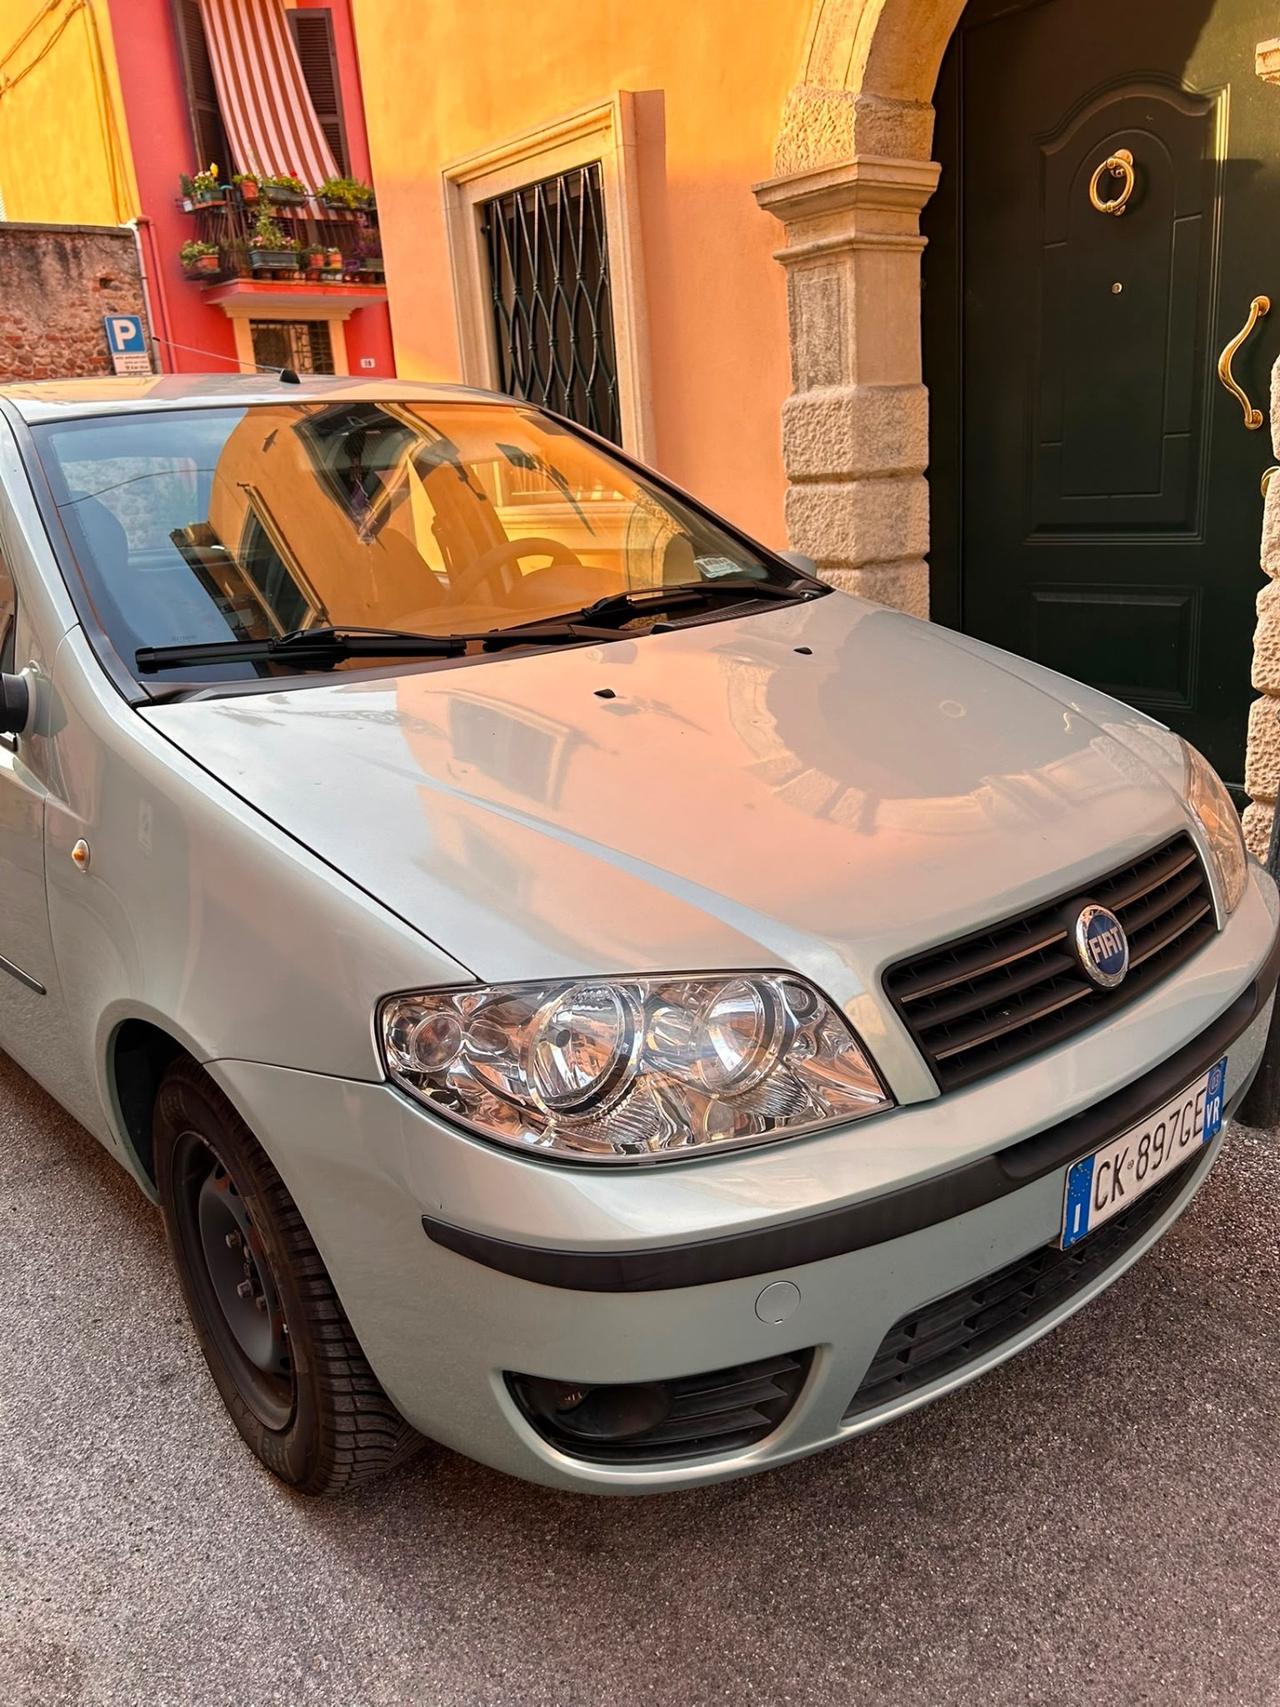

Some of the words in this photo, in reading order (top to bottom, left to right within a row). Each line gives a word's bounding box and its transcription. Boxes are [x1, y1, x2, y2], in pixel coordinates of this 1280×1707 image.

[112, 319, 136, 350] P
[1089, 926, 1122, 963] FIAT
[1206, 1096, 1220, 1128] VR
[1073, 1203, 1081, 1234] I
